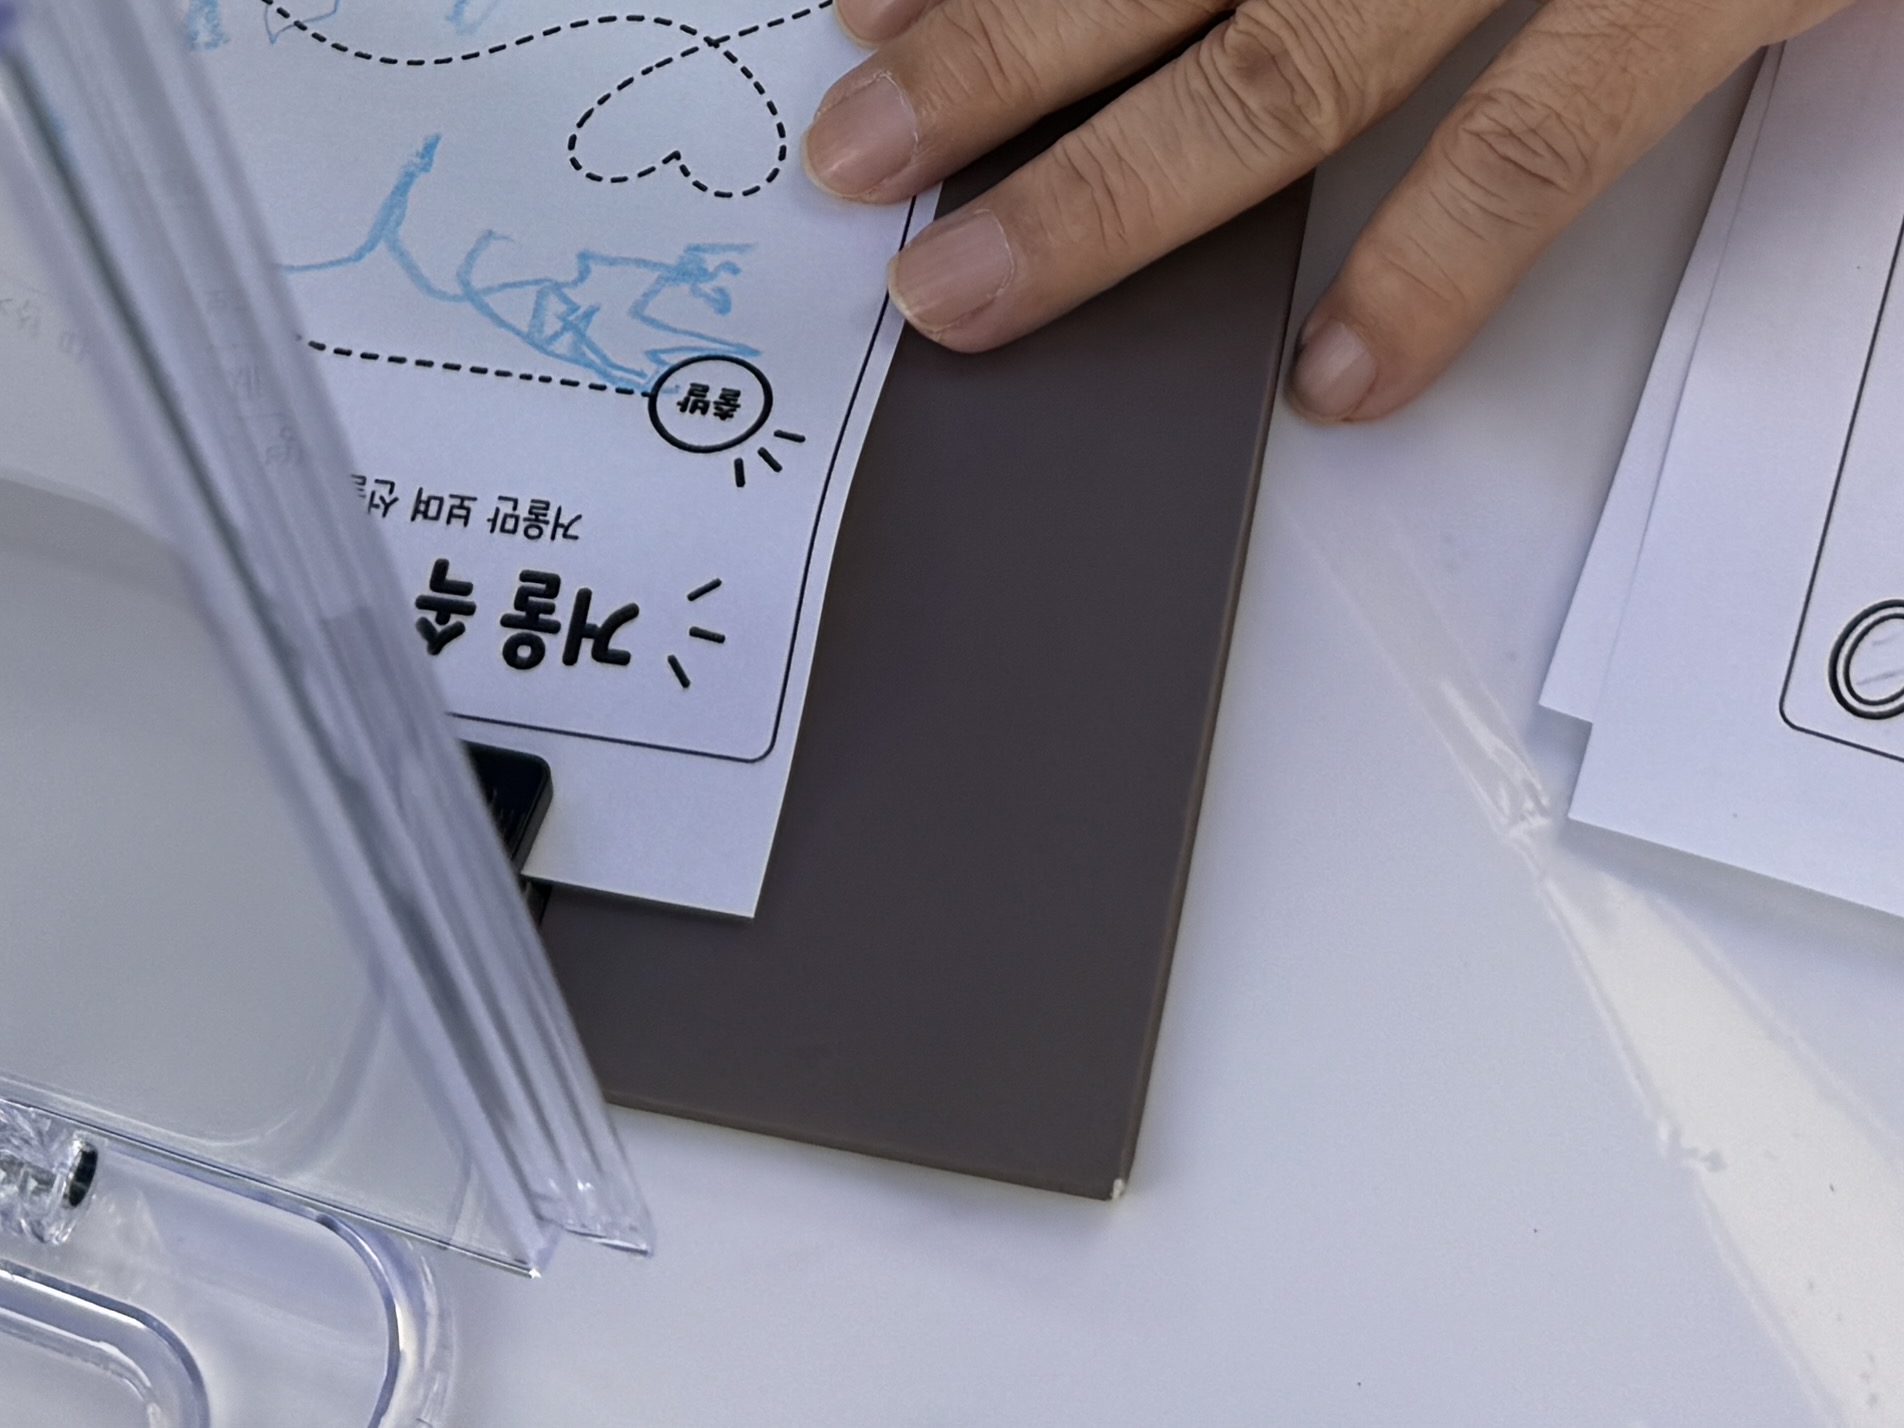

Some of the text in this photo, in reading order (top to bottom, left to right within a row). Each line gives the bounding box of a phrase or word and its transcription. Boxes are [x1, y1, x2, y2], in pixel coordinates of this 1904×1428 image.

[676, 382, 742, 421] 출발
[411, 486, 478, 528] 보며
[487, 496, 583, 543] 거울만
[415, 558, 641, 671] 거울 속
